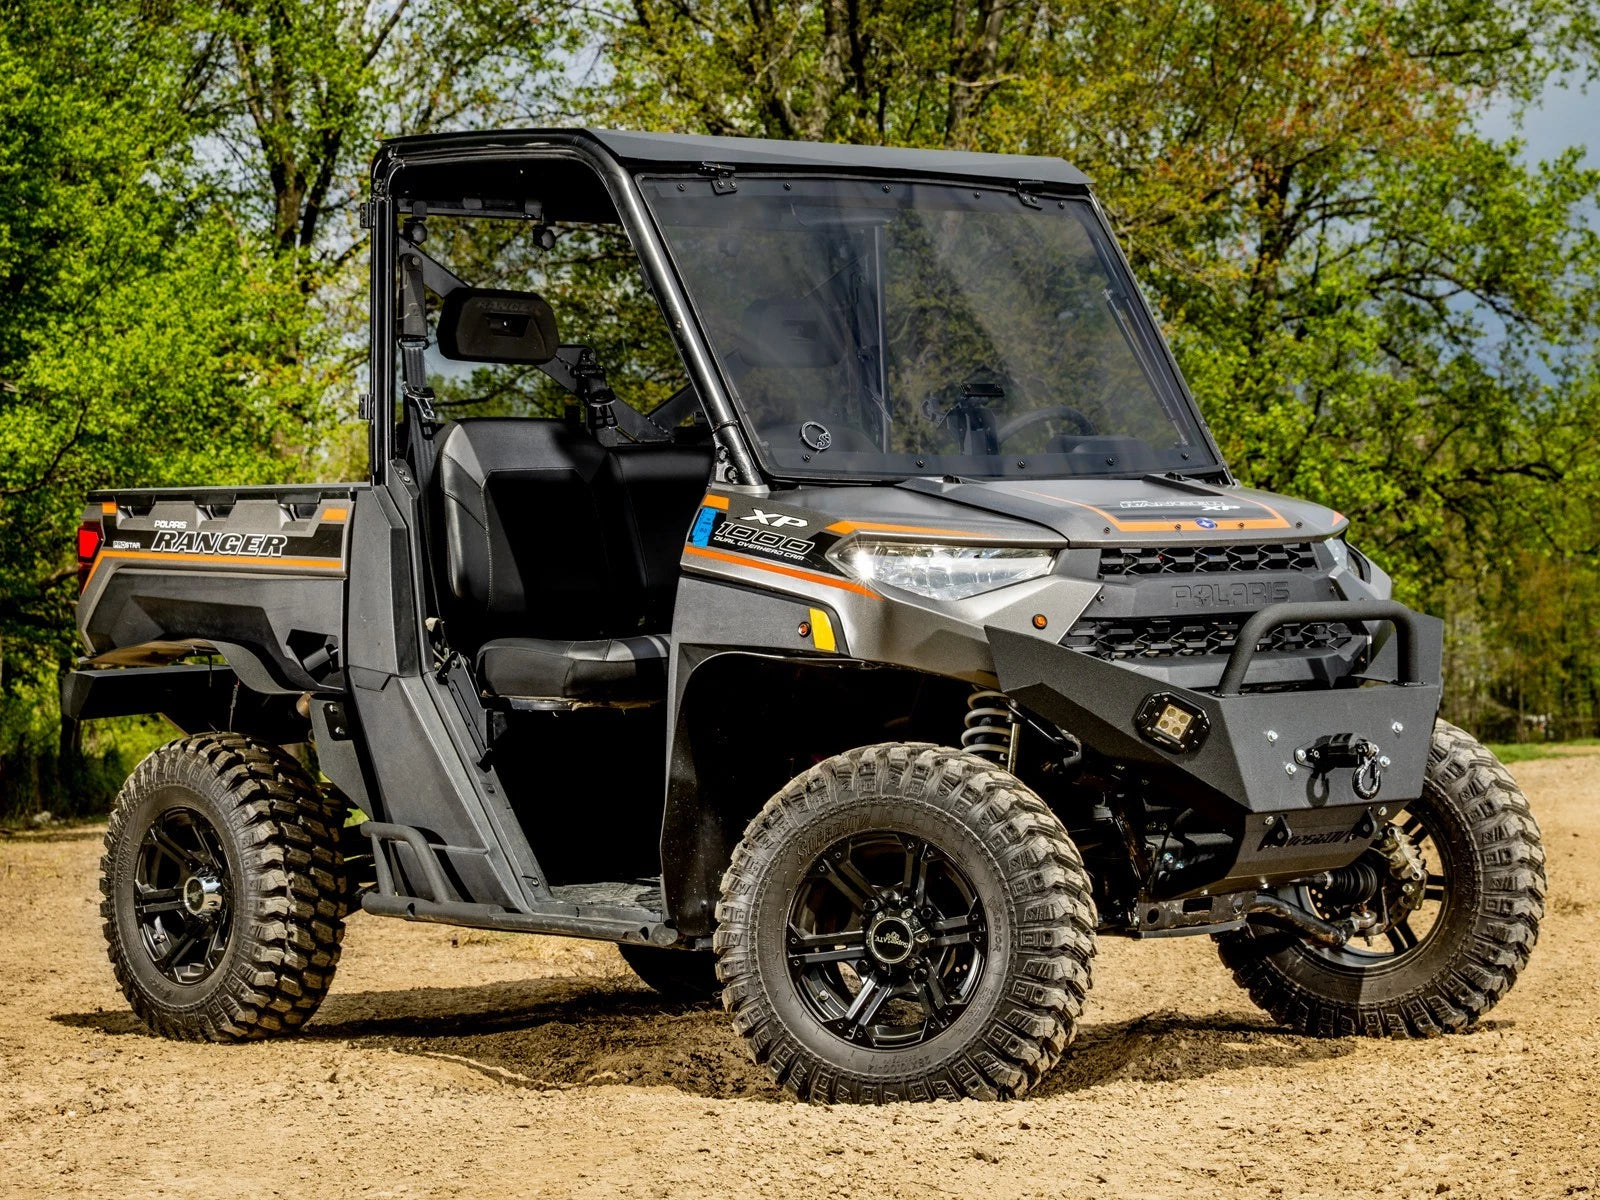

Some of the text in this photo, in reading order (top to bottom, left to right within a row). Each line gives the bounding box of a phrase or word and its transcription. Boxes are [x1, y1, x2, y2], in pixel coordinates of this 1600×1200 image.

[154, 520, 187, 530] POLARIS
[740, 508, 809, 528] XP
[150, 530, 288, 557] RANGER
[713, 536, 805, 561] DUAL OVERHEAD CAM
[714, 521, 816, 555] 1000
[1171, 581, 1290, 608] POLARIS
